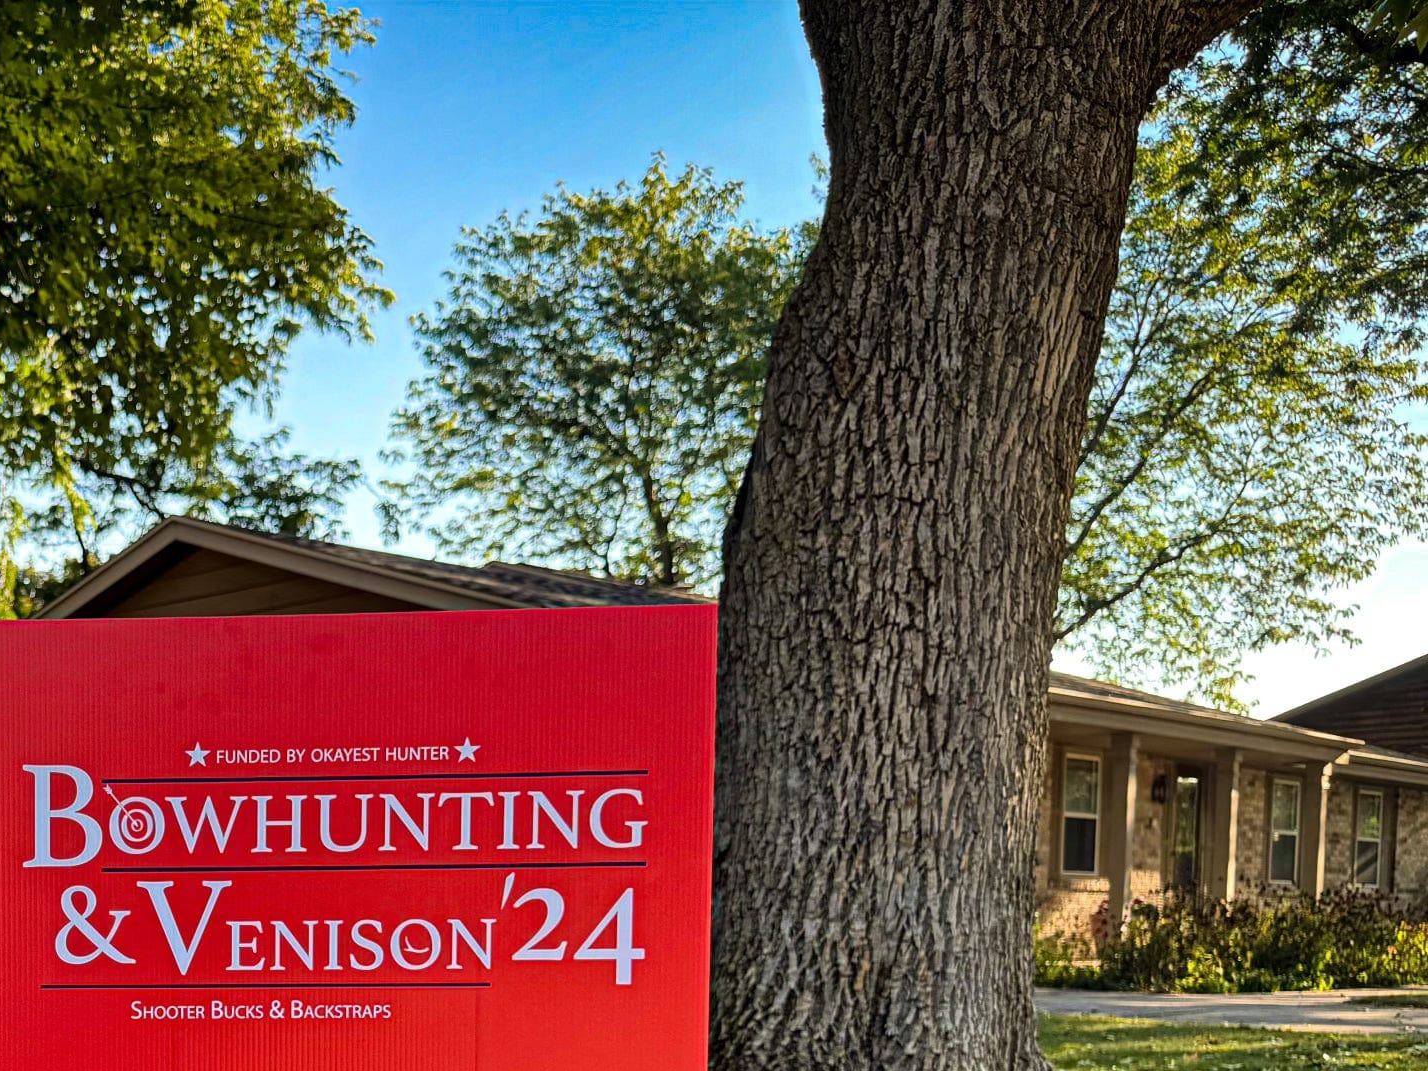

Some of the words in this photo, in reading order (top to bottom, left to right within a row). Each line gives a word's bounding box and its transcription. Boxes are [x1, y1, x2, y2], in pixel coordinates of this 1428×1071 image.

[216, 749, 281, 764] FUNDED
[286, 748, 306, 763] BY
[310, 747, 381, 763] OKAYEST
[385, 746, 449, 761] HUNTER
[22, 764, 649, 868] BOWHUNTING
[54, 885, 137, 965] &
[136, 880, 497, 976] VENISON
[500, 871, 646, 986] '24
[130, 1000, 205, 1020] SHOOTER
[211, 1000, 264, 1020] BUCKS
[269, 999, 285, 1019] &
[290, 999, 392, 1019] BACKSTRAPS
